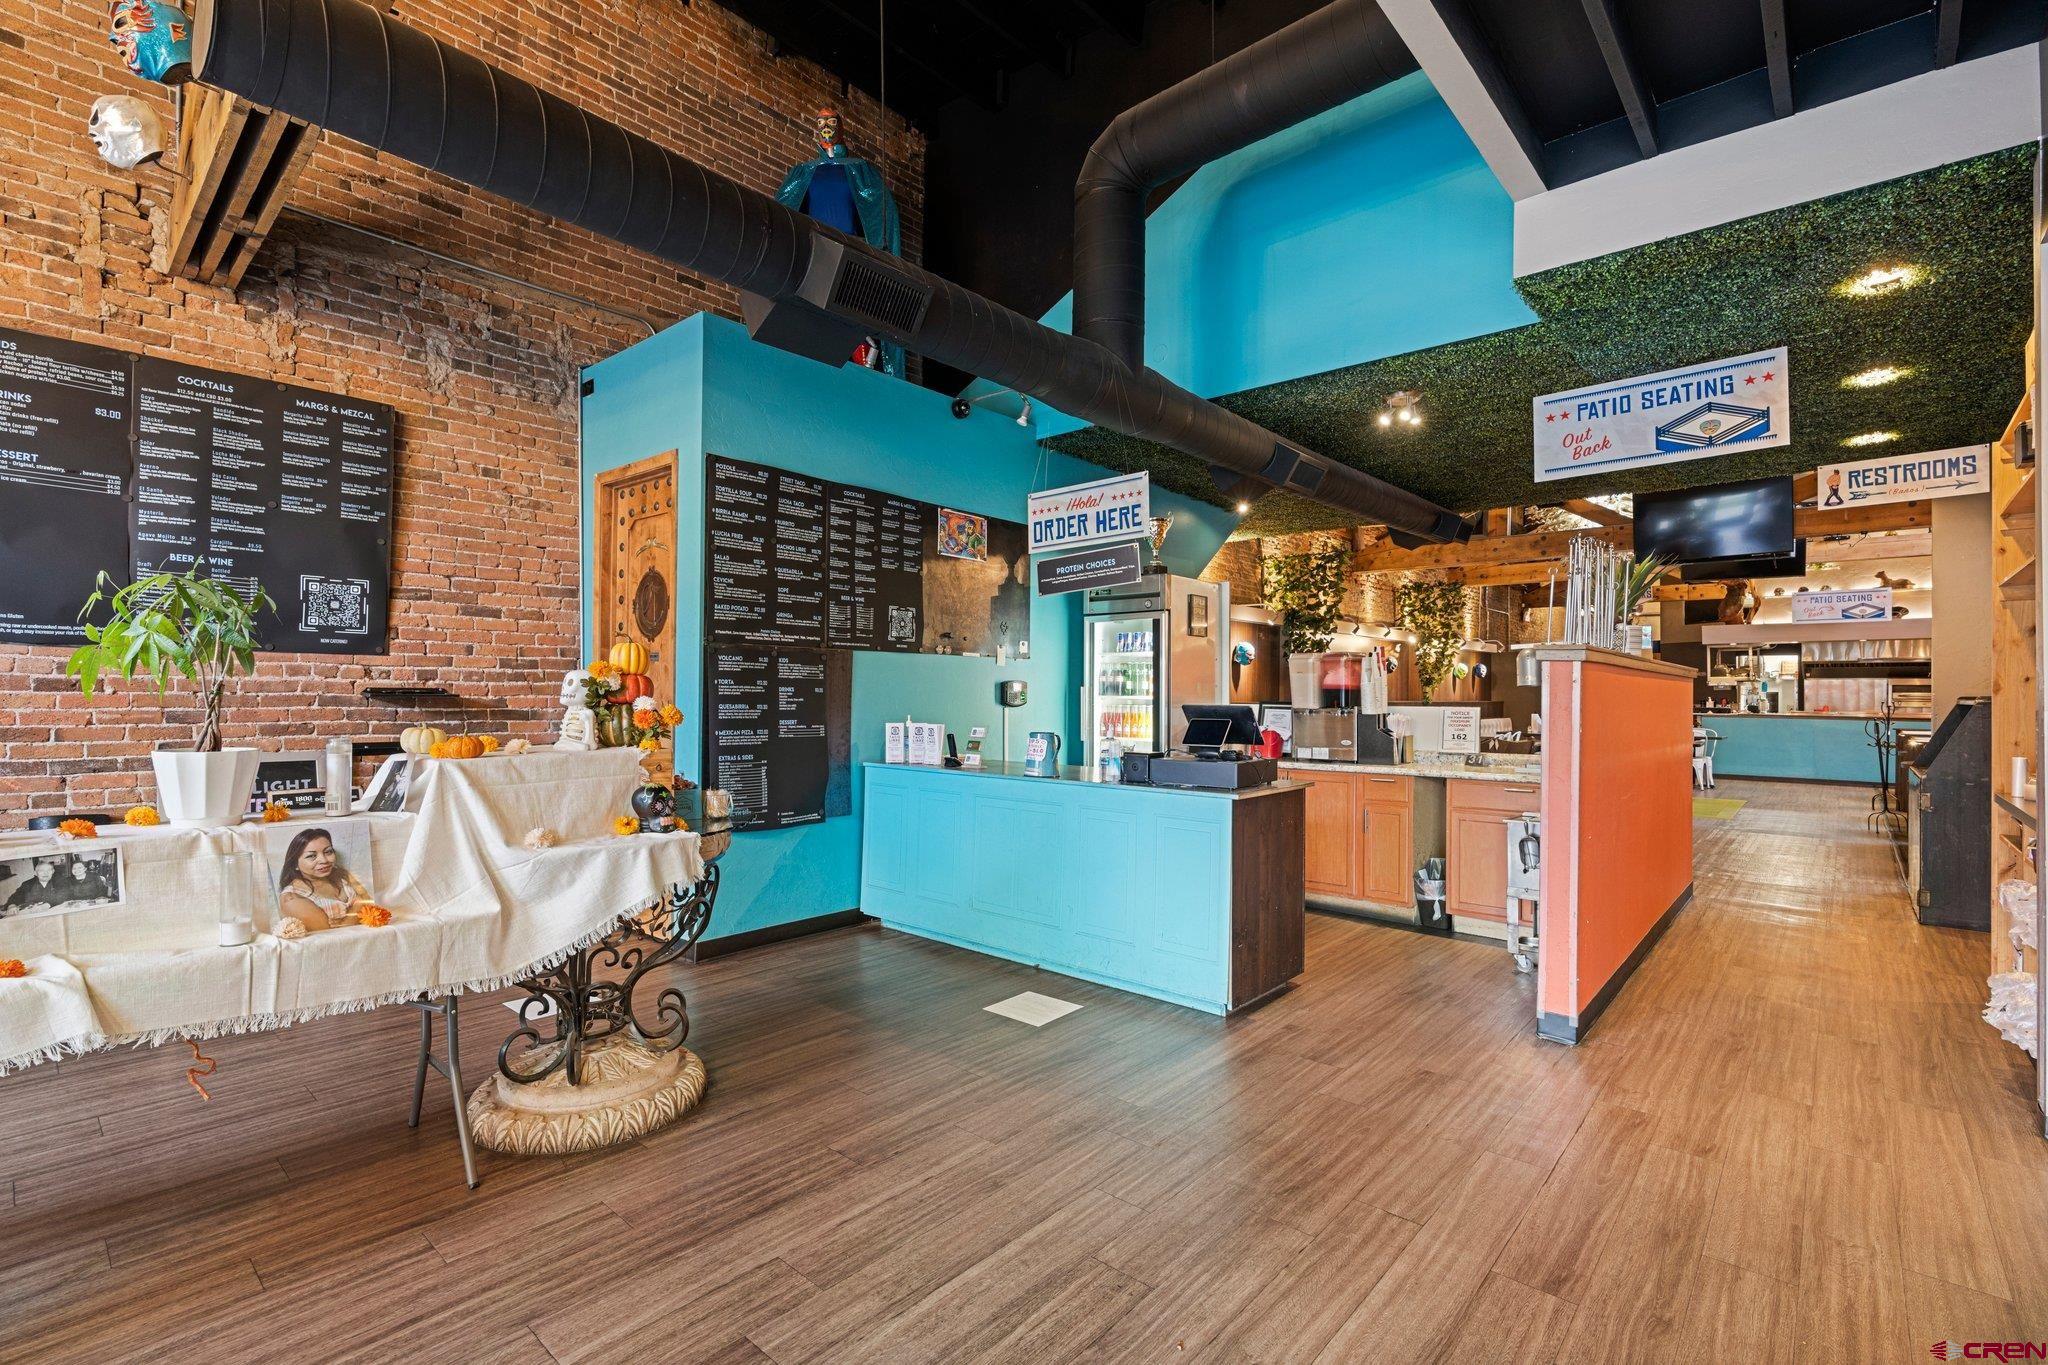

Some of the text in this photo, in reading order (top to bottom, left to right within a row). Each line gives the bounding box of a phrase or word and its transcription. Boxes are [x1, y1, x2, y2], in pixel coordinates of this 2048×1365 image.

[0, 340, 17, 350] DS
[16, 351, 34, 359] cheese
[16, 372, 38, 380] nuggets
[28, 368, 47, 376] protein
[177, 375, 234, 393] COCKTAILS
[1577, 375, 1734, 421] PATIO SEATING
[95, 407, 121, 420] $3.00
[296, 399, 375, 420] MARGS & MEZCAL
[1562, 427, 1593, 448] Out
[1572, 435, 1612, 461] Back
[0, 449, 38, 462] SSERT
[1848, 454, 1977, 489] RESTROOMS
[715, 486, 739, 495] TORTILLA
[1066, 492, 1104, 512] ¡Hola!
[1033, 504, 1142, 544] ORDER HERE
[715, 530, 730, 538] LUCHA
[776, 544, 795, 552] NACHOS
[170, 553, 194, 562] BEER
[208, 557, 234, 567] WINE
[1056, 559, 1116, 574] PROTEIN CHOICES
[713, 576, 734, 584] CEVICHE
[1810, 594, 1872, 604] PATIO SEATING
[253, 779, 311, 794] LIGHT
